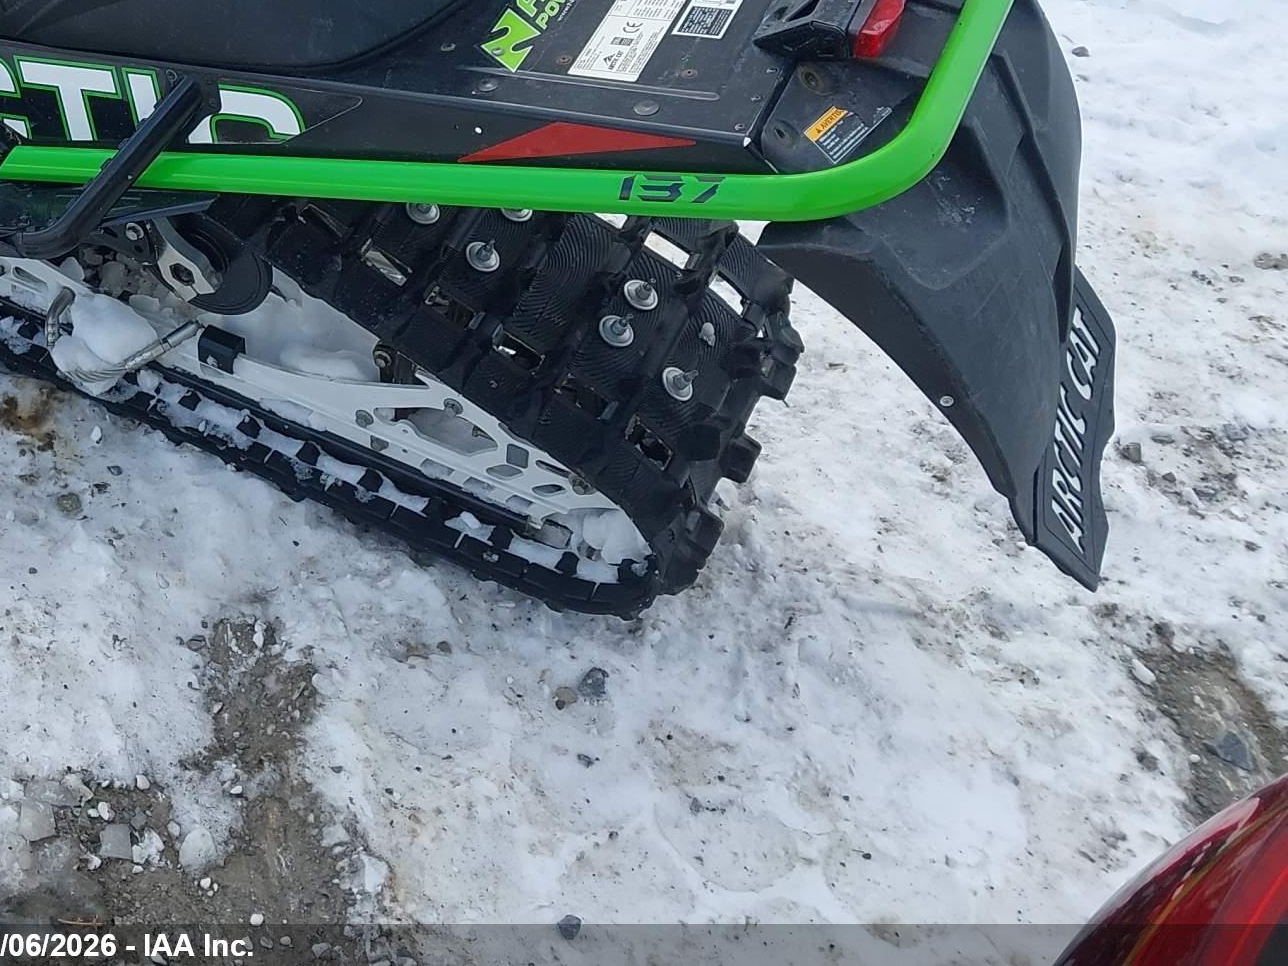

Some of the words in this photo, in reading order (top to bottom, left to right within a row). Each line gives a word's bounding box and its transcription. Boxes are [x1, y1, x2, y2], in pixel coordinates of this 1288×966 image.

[618, 173, 726, 205] 137
[1066, 305, 1101, 401] CAT
[1051, 383, 1087, 555] ARCTIC
